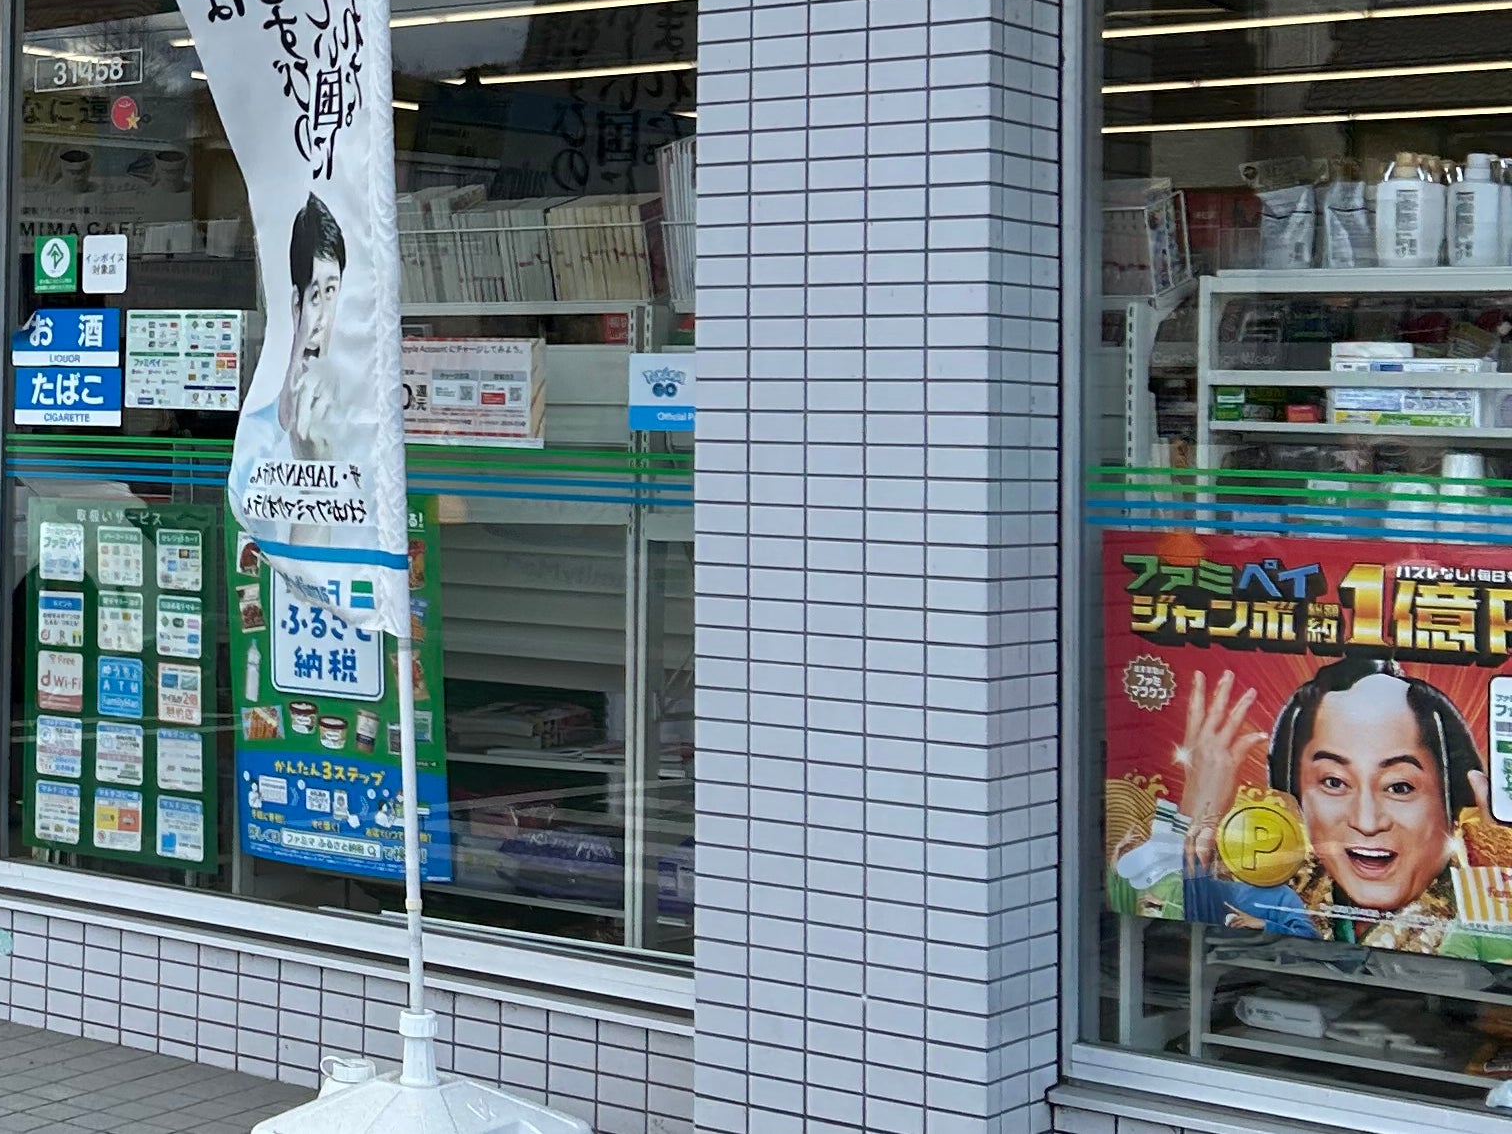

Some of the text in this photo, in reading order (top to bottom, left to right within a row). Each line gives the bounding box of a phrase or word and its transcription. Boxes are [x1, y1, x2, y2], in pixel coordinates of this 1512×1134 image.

[86, 252, 125, 263] インボイス
[92, 264, 116, 275] 対象店
[49, 353, 81, 363] LIQUOR
[31, 372, 104, 406] たばこ
[44, 412, 90, 423] CIGARETTE
[1122, 556, 1320, 599] ファミペイ
[294, 646, 358, 683] 納税
[53, 678, 81, 691] Wi-Fi
[274, 759, 386, 786] かんたん3ステップ
